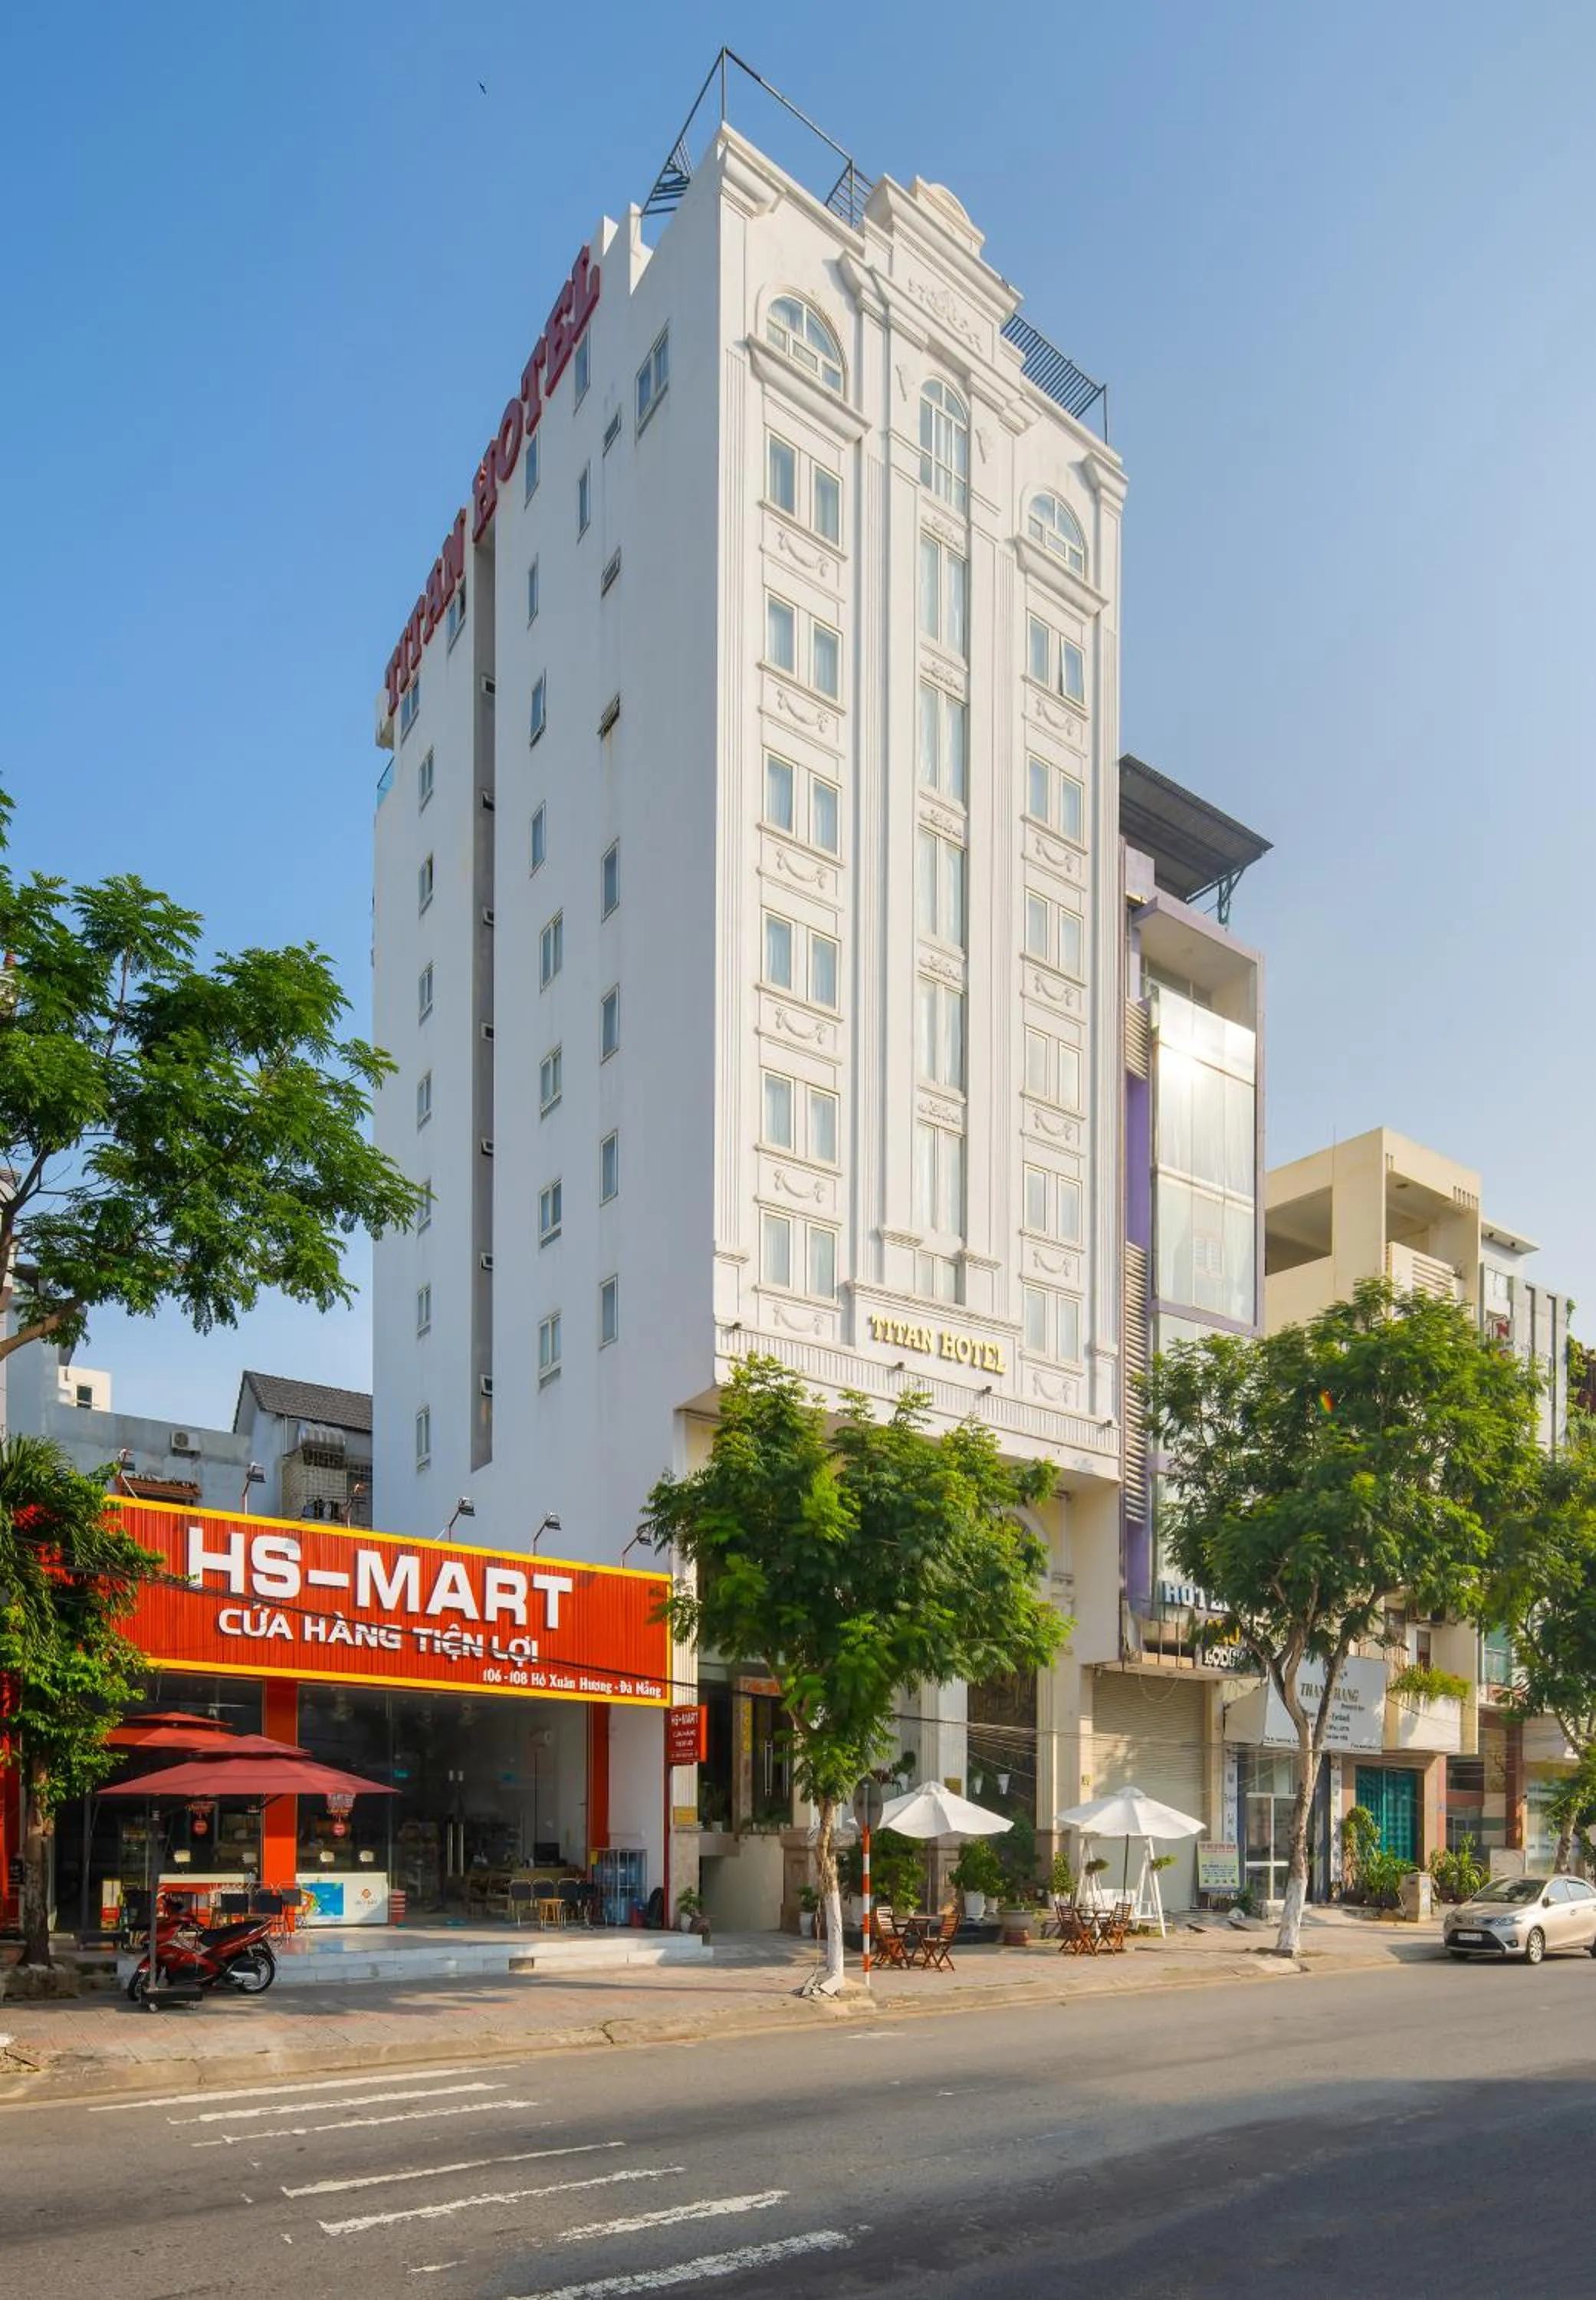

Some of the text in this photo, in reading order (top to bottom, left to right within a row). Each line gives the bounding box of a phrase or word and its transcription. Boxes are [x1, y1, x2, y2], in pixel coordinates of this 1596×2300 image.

[472, 245, 600, 543] HOTEL
[871, 1313, 1007, 1375] TITAN HOTEL
[188, 1526, 573, 1629] HS-MART
[1164, 1581, 1230, 1612] HOT
[304, 1611, 402, 1649] HÀNG
[412, 1623, 484, 1661] TIỆN
[491, 1635, 538, 1668] LỢI
